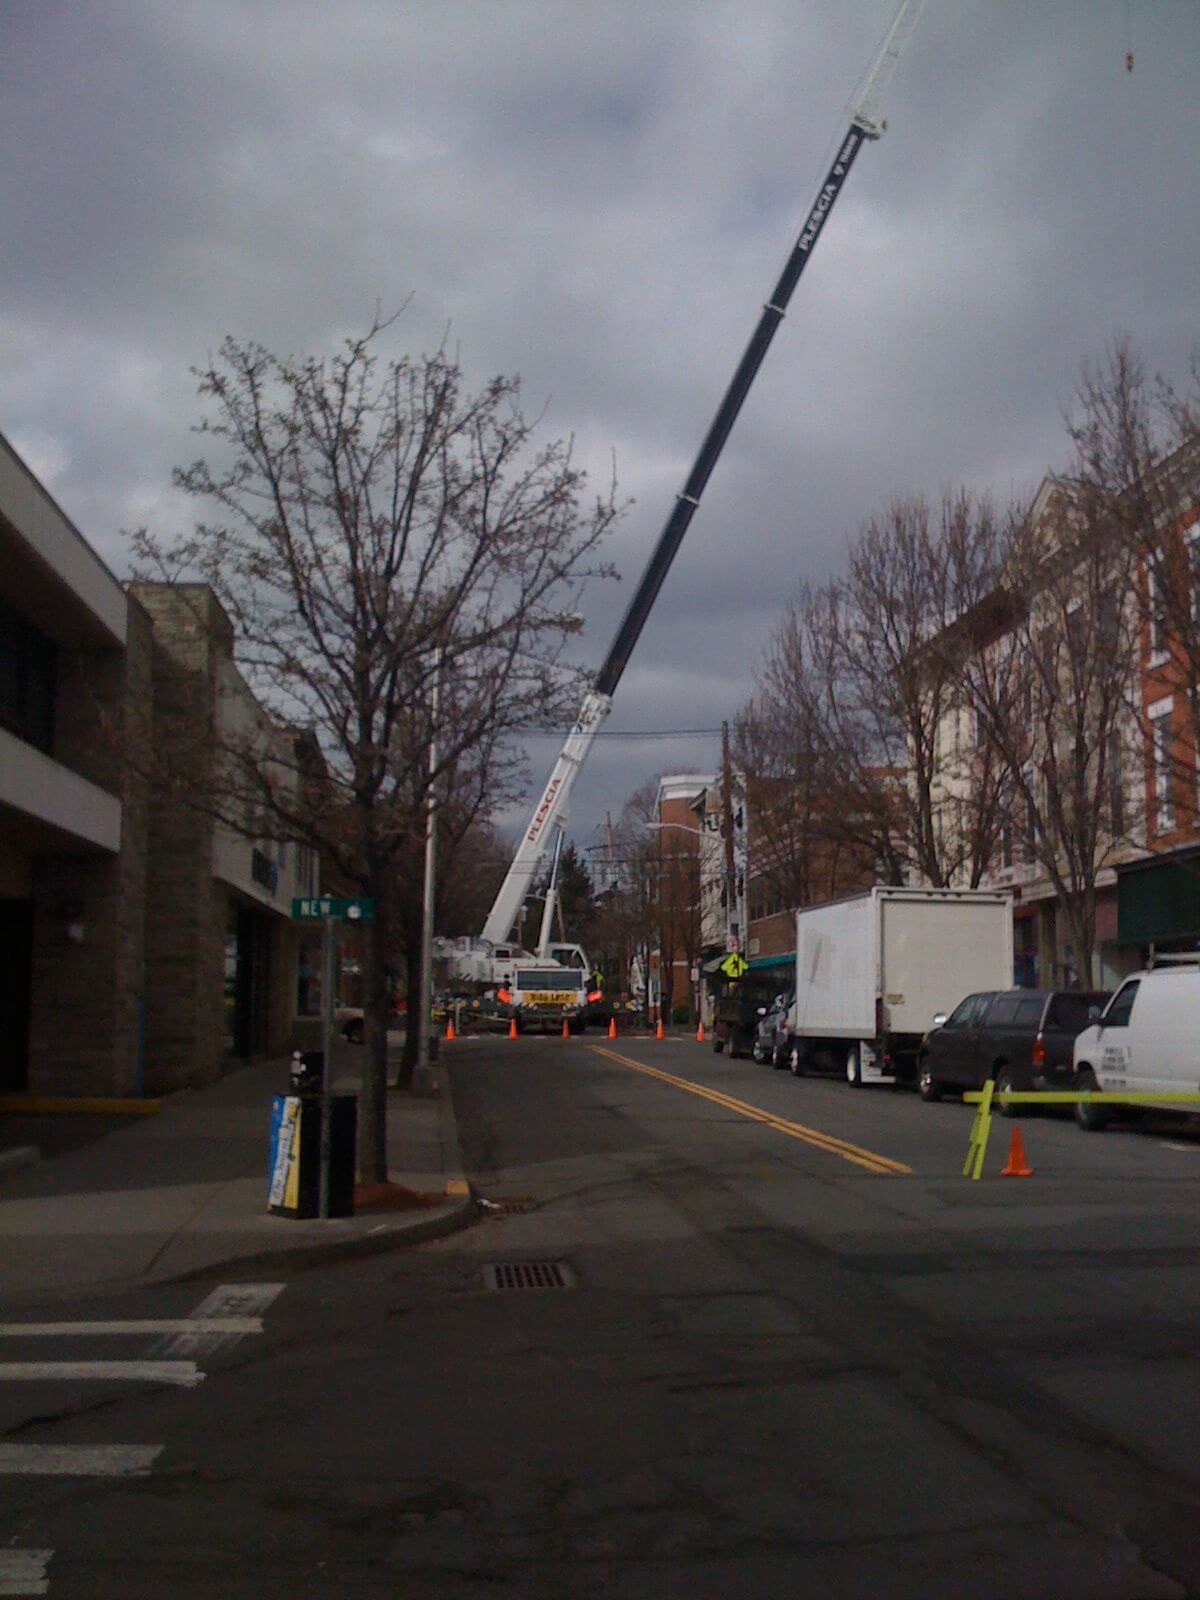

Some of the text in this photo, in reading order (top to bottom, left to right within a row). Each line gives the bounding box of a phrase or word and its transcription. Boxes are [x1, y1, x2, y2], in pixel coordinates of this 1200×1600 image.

[798, 184, 837, 251] PLESCIA
[528, 779, 561, 841] PLESCIA
[301, 900, 330, 916] NEW
